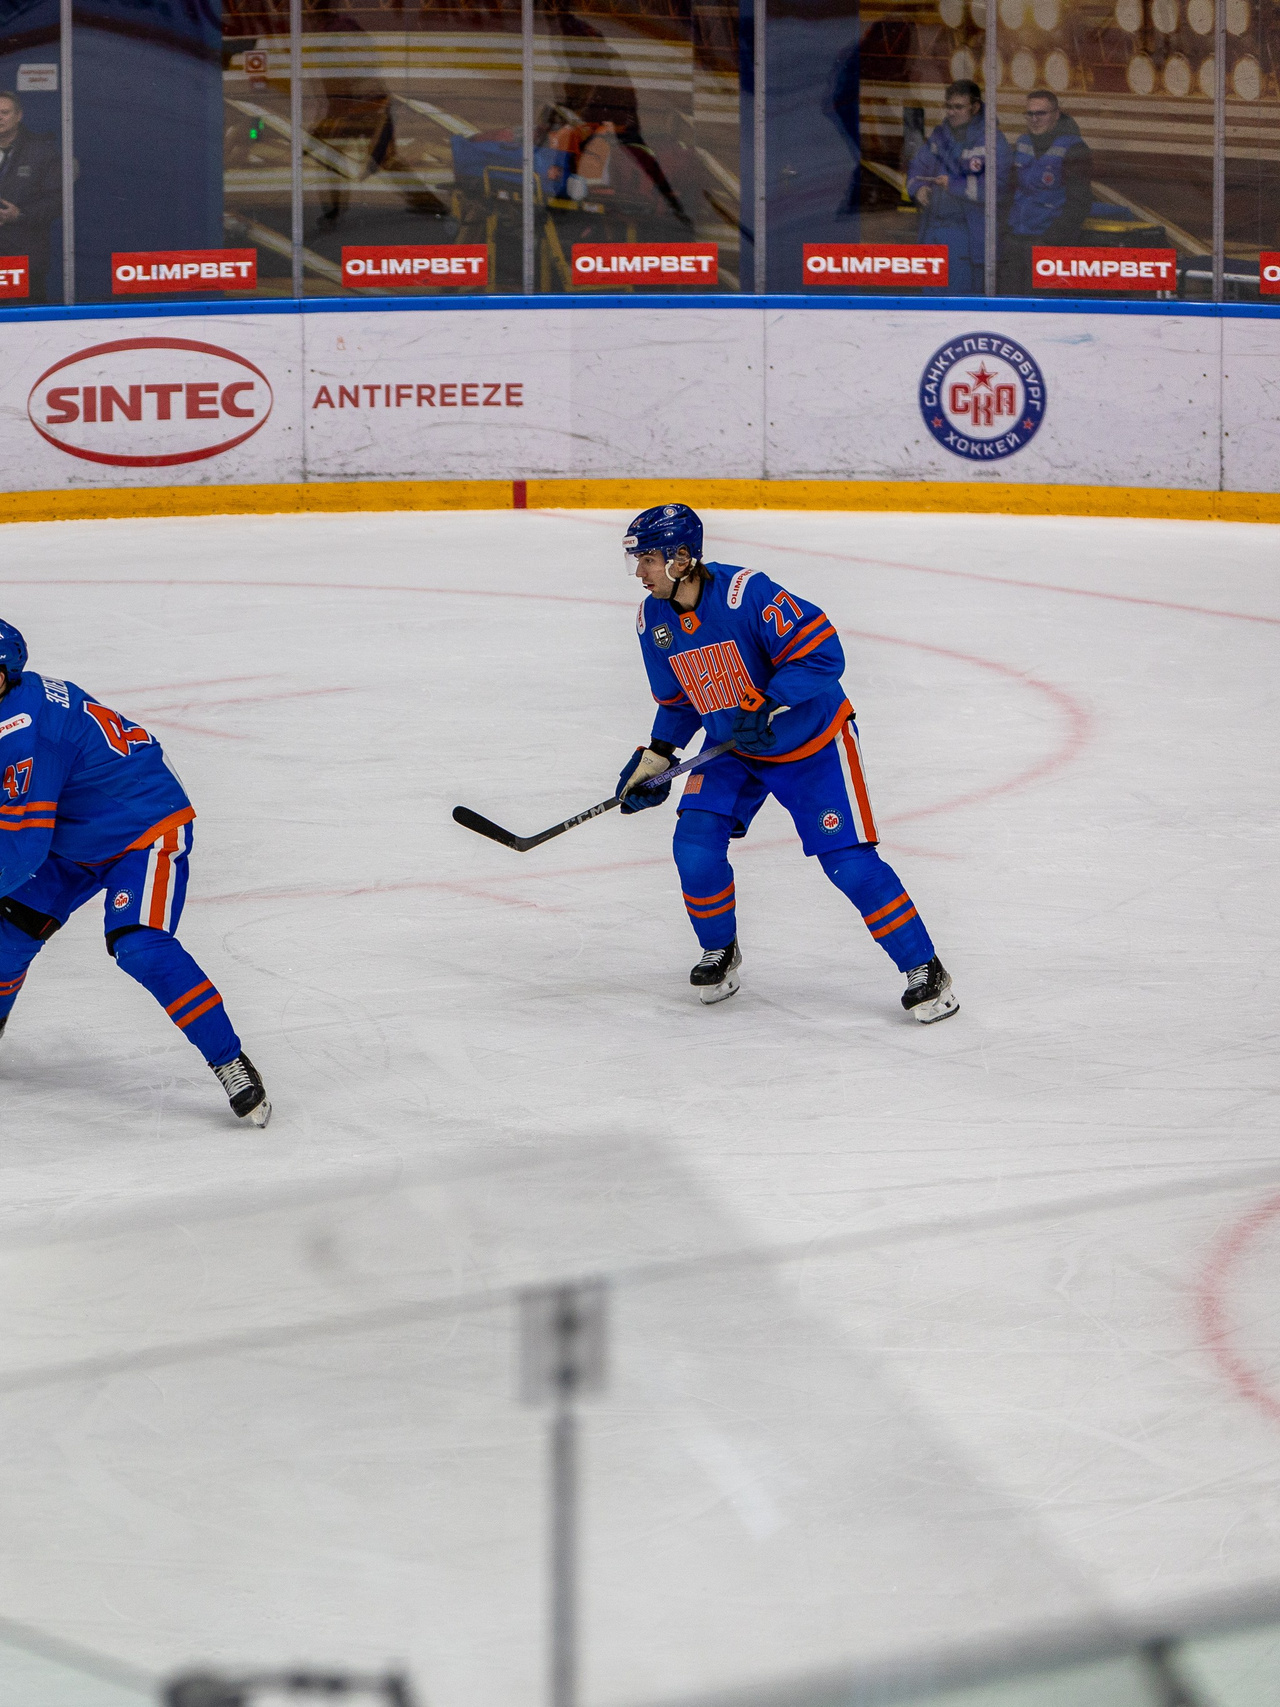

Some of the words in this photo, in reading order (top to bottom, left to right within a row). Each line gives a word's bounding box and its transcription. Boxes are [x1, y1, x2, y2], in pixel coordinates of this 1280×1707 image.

[115, 261, 253, 282] OLIMPBET
[345, 257, 484, 276] OLIMPBET
[575, 255, 714, 274] OLIMPBET
[806, 256, 945, 275] OLIMPBET
[1035, 259, 1172, 278] OLIMPBET
[924, 337, 1041, 412] САНКТ-ПЕТЕРБУРГ
[45, 381, 255, 424] SINTEC
[313, 383, 524, 408] ANTIFREEZE
[949, 382, 1017, 426] СКА
[943, 431, 1021, 456] ХОККЕЙ
[761, 589, 803, 637] 27
[3, 757, 33, 800] 47
[564, 802, 607, 831] CCM
